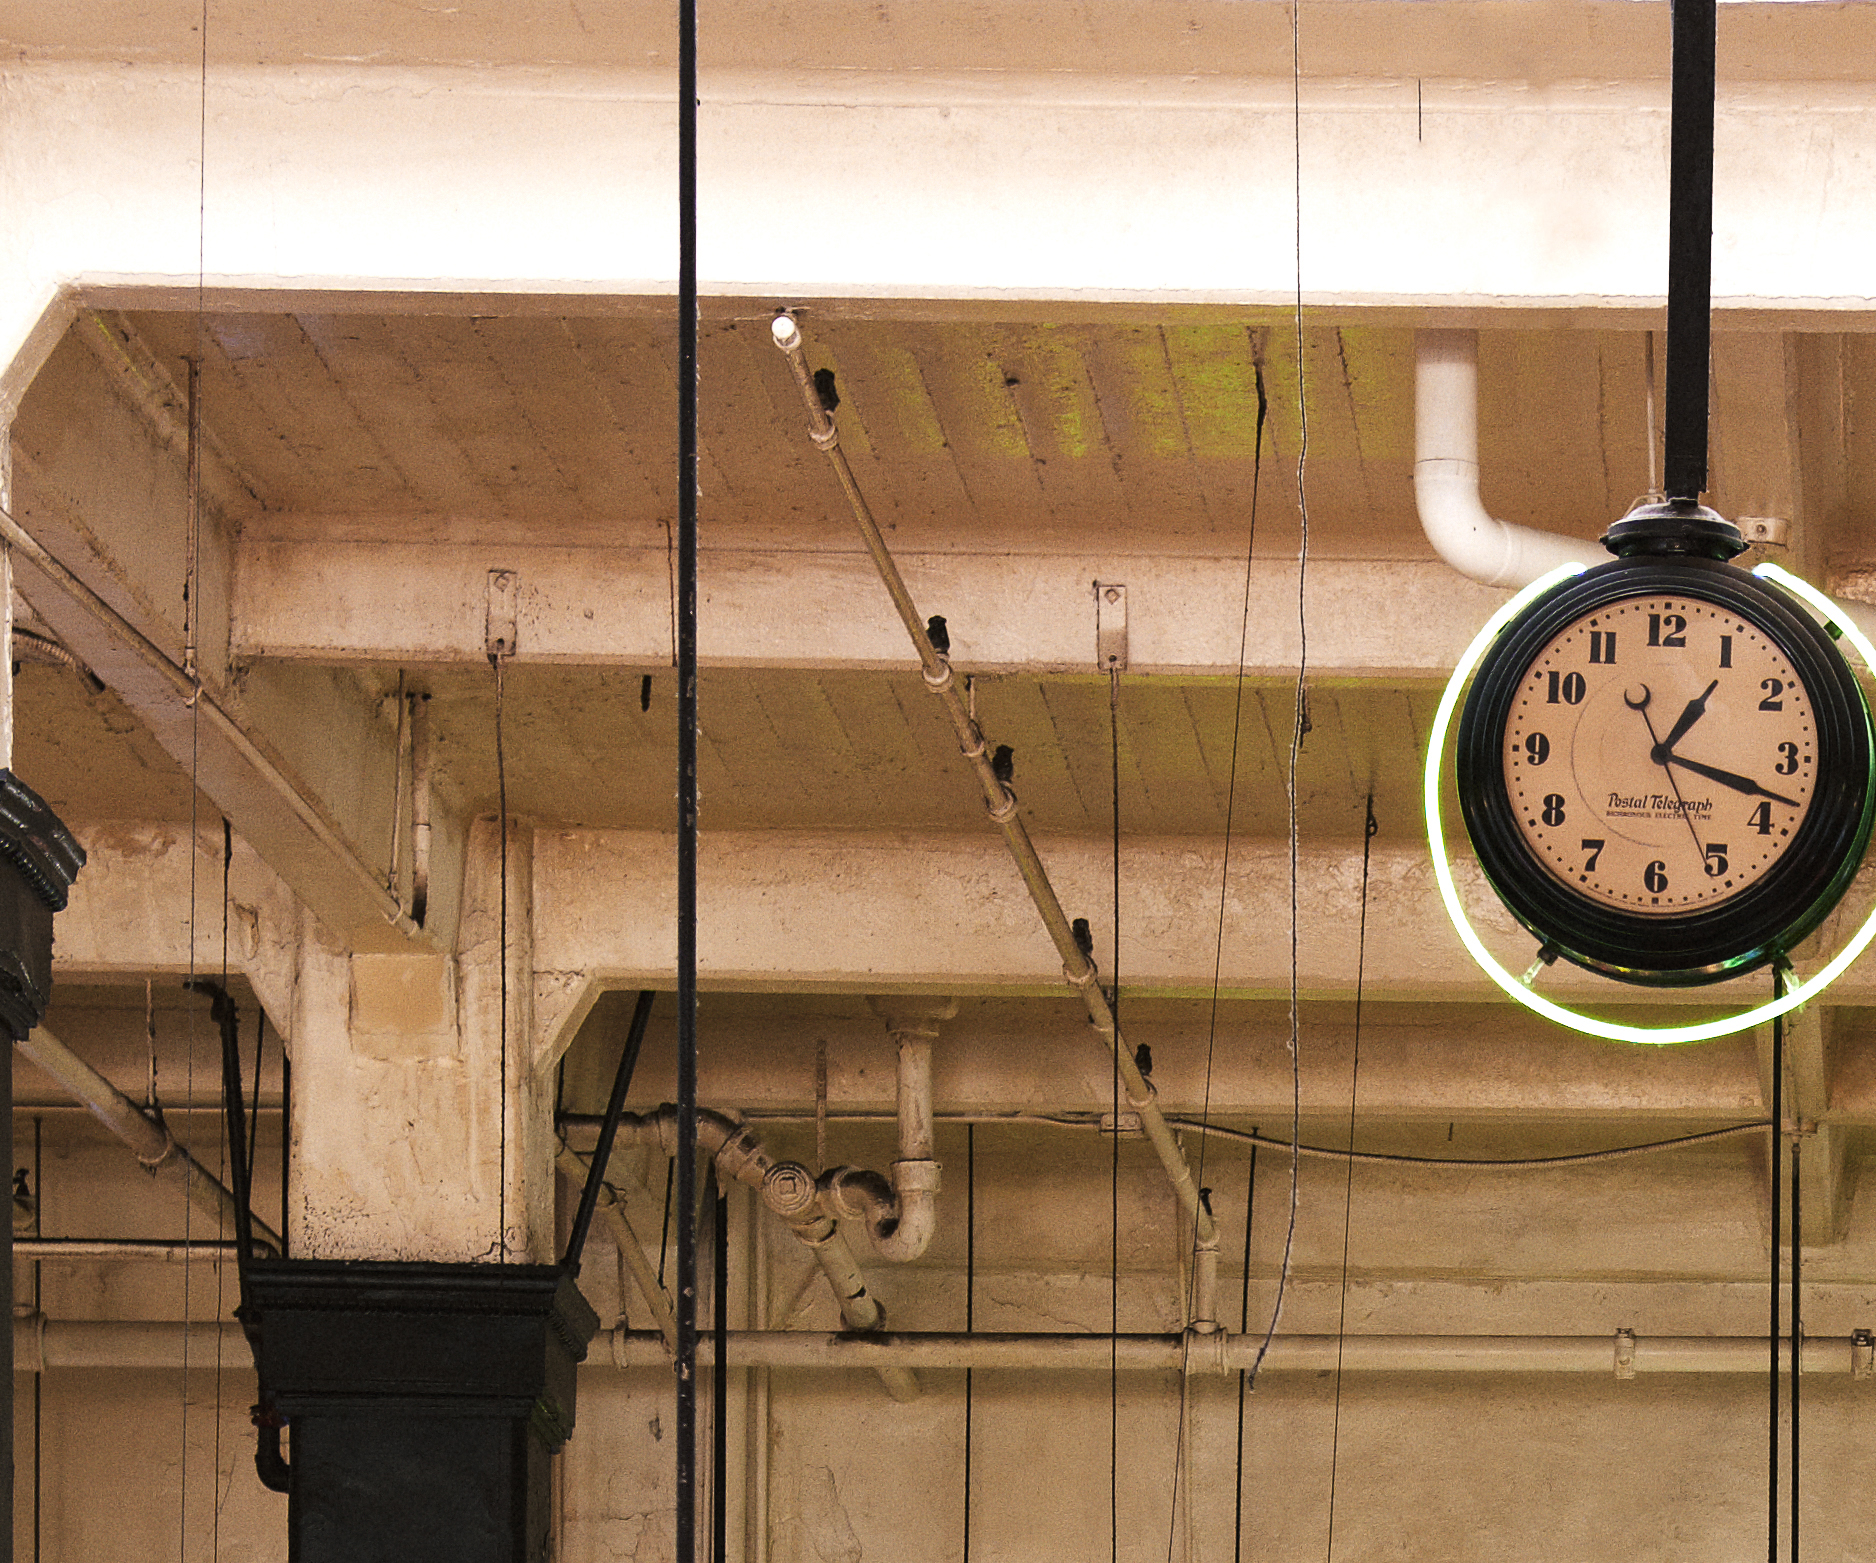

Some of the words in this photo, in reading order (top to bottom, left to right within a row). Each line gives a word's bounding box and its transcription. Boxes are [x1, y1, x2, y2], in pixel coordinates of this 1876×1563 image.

[1647, 613, 1687, 648] 12
[1588, 631, 1617, 665] 11
[1719, 635, 1732, 669] 1
[1546, 670, 1586, 705] 10
[1758, 678, 1784, 712] 2
[1525, 732, 1550, 766] 9
[1775, 741, 1799, 776] 3
[1541, 793, 1566, 827] 8
[1608, 792, 1648, 809] Postal
[1650, 794, 1713, 814] Telegraph
[1747, 801, 1775, 835] 4
[1581, 839, 1605, 872] 7
[1704, 843, 1729, 877] 5
[1643, 860, 1669, 894] 6
